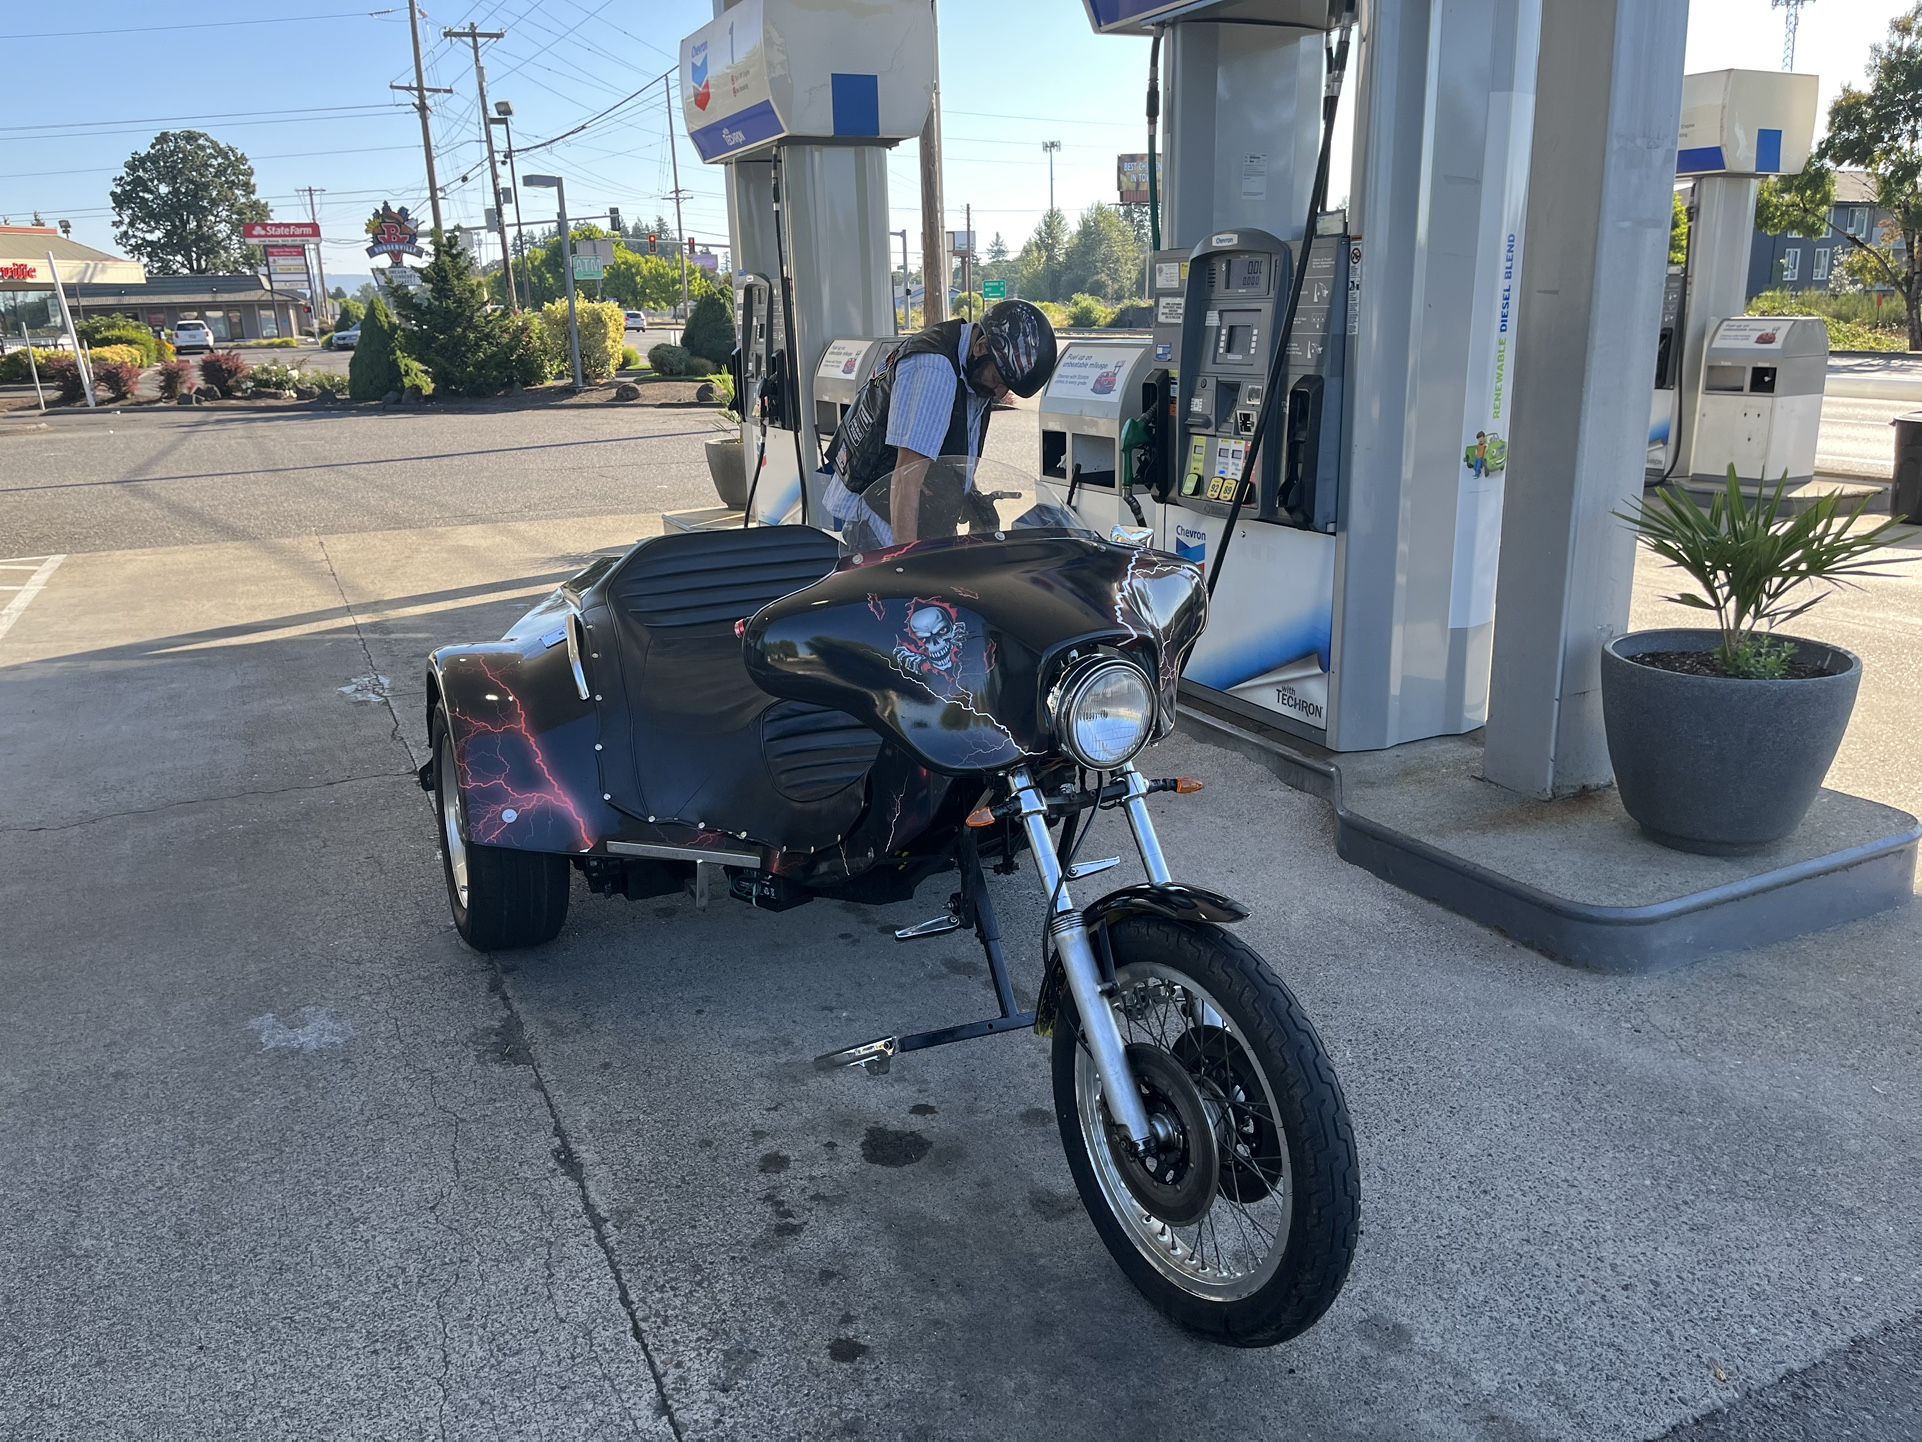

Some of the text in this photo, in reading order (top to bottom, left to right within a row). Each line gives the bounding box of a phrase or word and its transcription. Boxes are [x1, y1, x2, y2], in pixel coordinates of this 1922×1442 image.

[691, 40, 708, 58] Chevron
[1123, 162, 1137, 171] BEST
[373, 244, 417, 254] BURGERVILLE
[576, 259, 601, 272] ATM
[1492, 233, 1516, 419] RENEWABLE DIESEL BLEND
[1210, 483, 1233, 496] 92 89
[1176, 524, 1206, 541] Chevron
[1282, 685, 1296, 696] with
[1275, 688, 1322, 719] TECHRON
